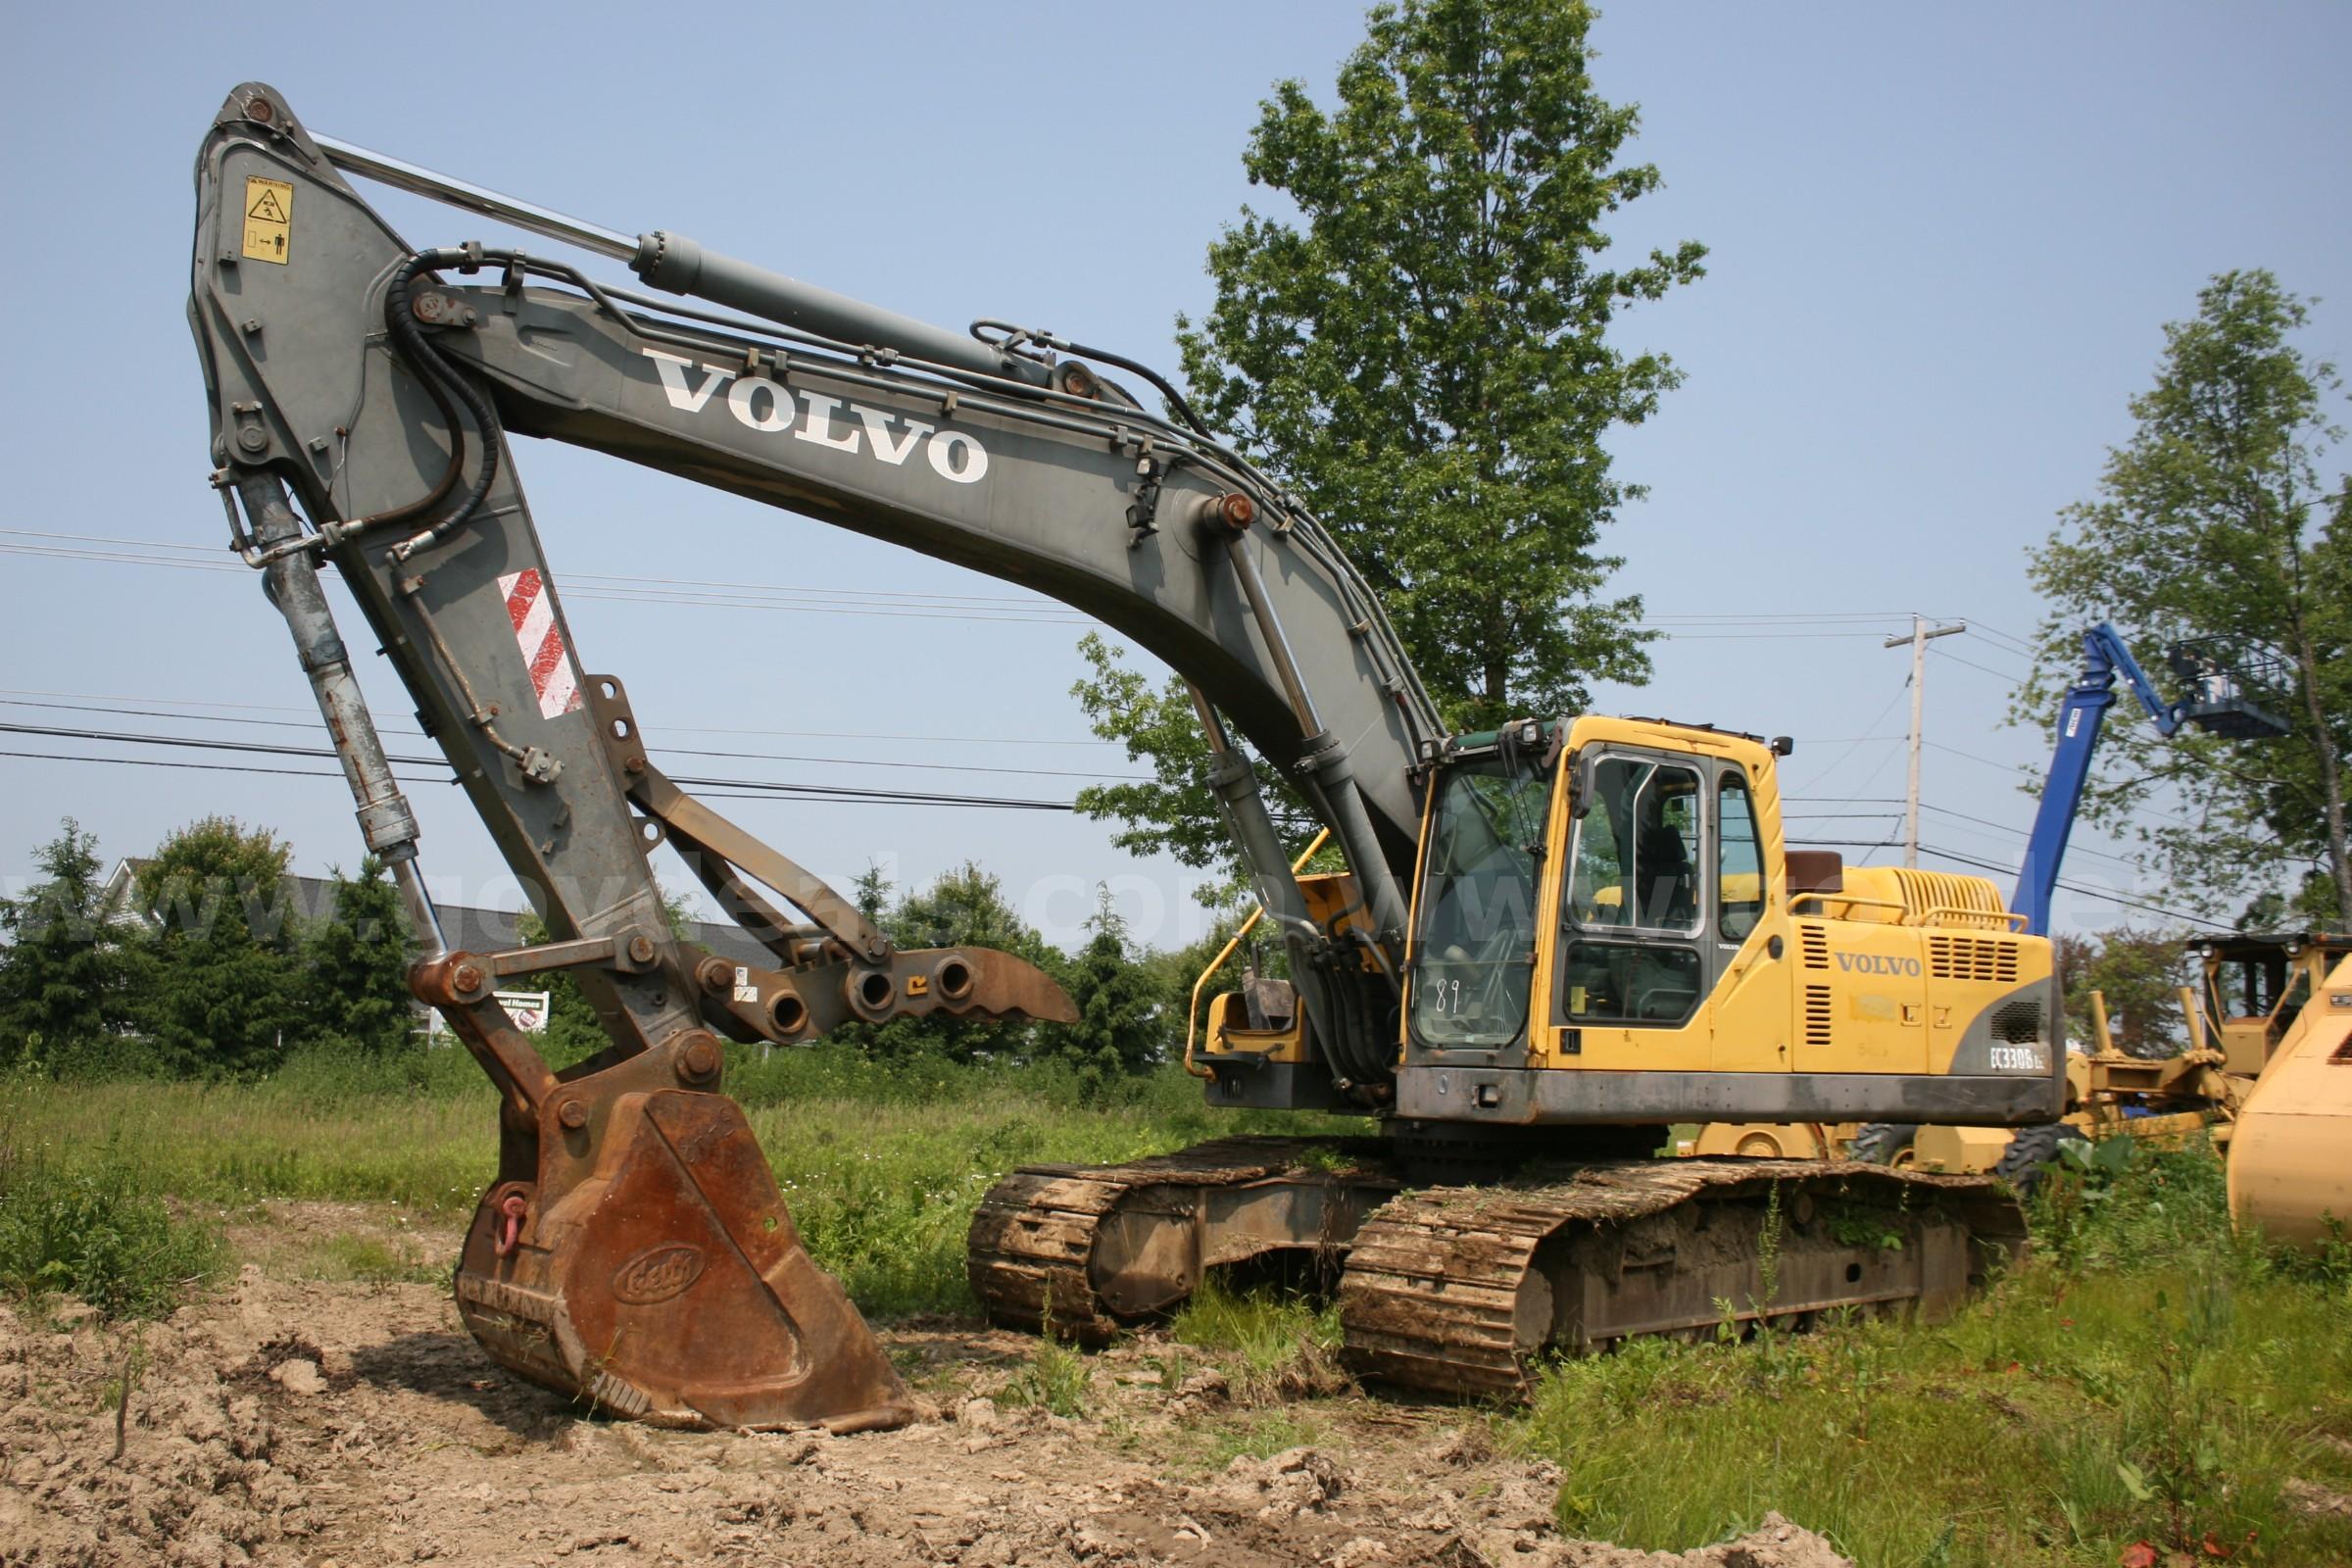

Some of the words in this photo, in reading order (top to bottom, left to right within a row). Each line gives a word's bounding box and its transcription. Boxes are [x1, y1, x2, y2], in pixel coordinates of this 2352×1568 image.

[642, 347, 989, 483] VOLVO
[1834, 952, 1922, 977] VOLVO
[512, 999, 541, 1008] Homes
[1436, 978, 1460, 1013] 89
